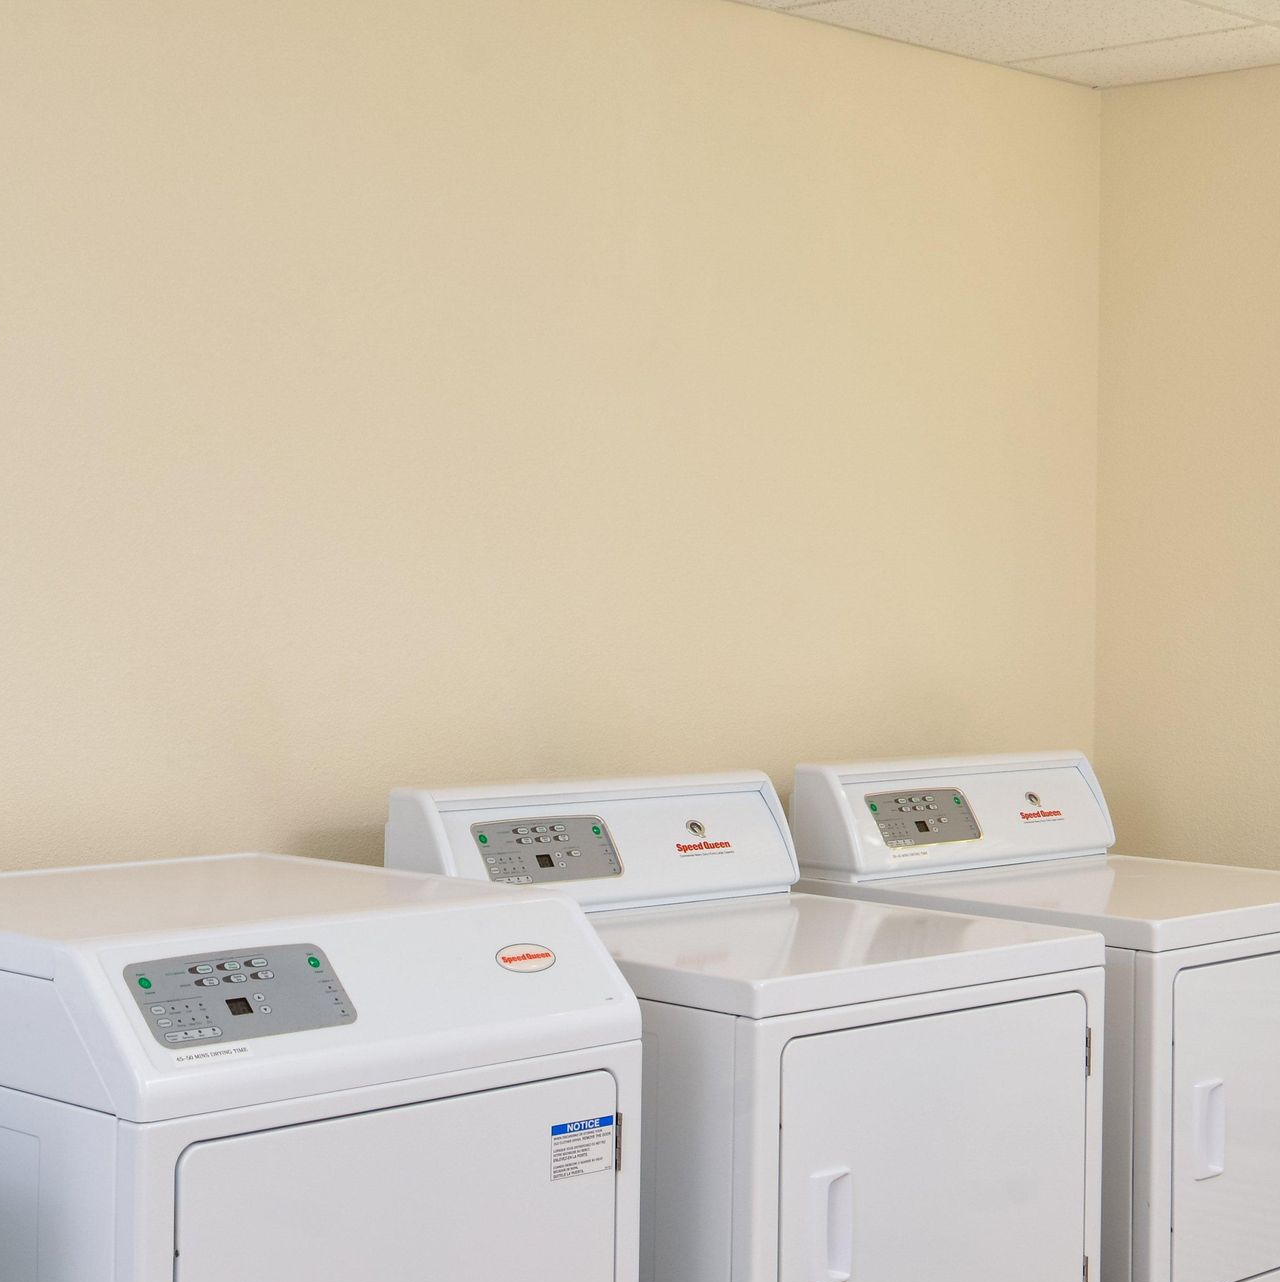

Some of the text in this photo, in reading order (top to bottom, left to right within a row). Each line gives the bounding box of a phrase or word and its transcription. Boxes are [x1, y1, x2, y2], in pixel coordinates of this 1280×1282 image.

[1020, 811, 1041, 820] Speed
[676, 841, 731, 853] Speed Queen
[501, 952, 551, 964] Speed Queen
[566, 1119, 600, 1132] NOTICE
